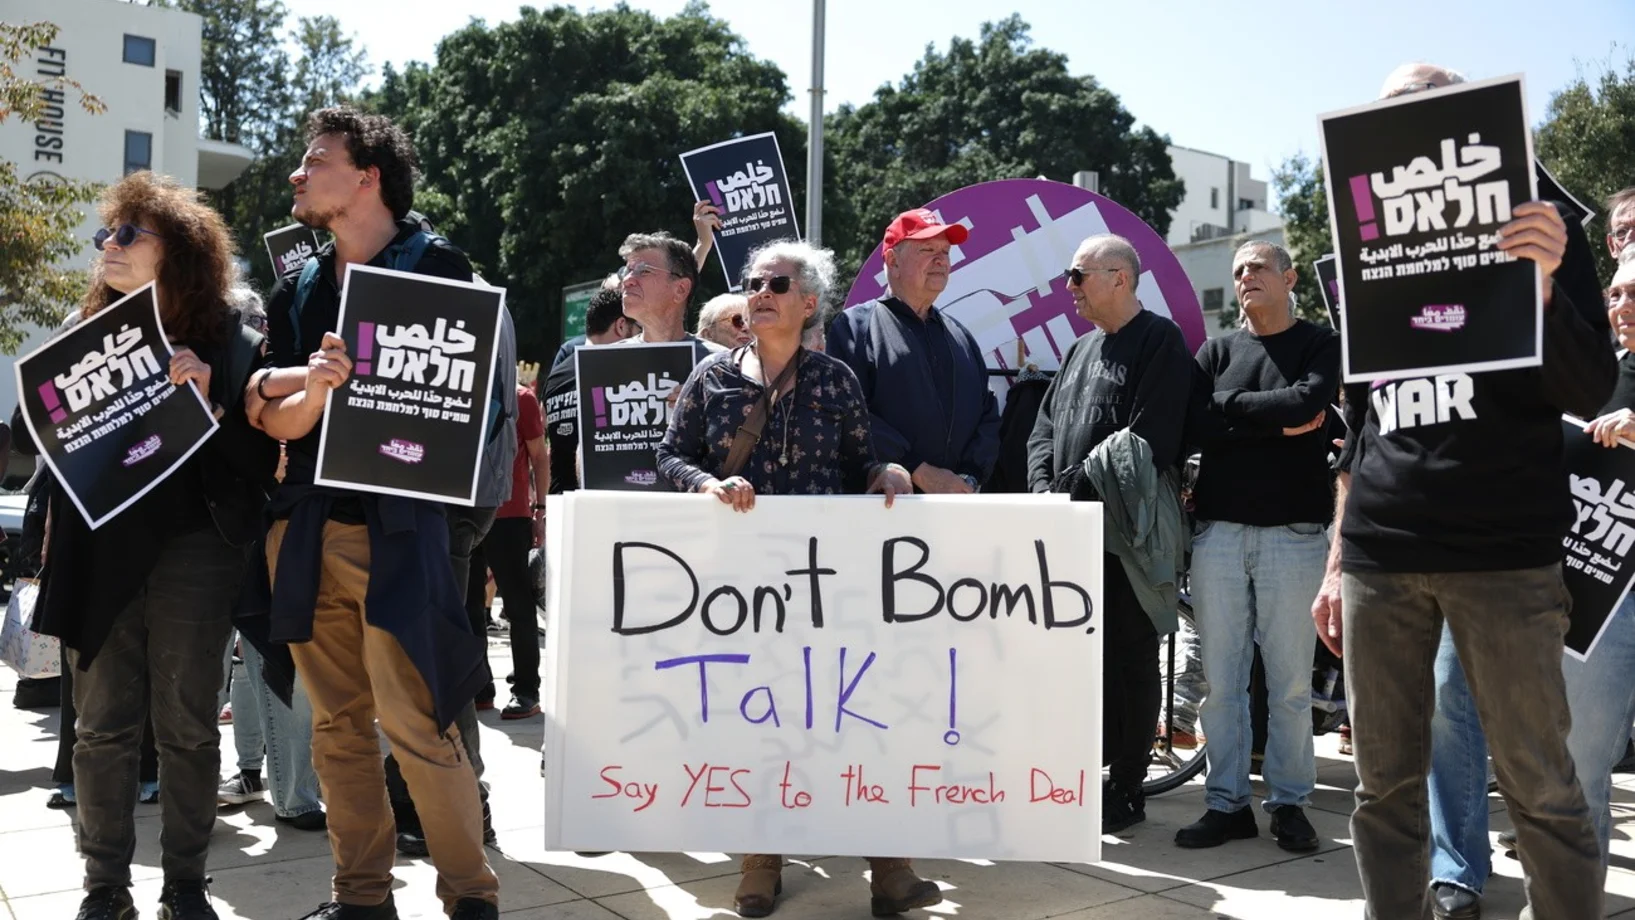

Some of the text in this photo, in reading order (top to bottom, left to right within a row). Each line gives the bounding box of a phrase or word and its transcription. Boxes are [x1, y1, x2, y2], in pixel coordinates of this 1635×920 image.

[716, 159, 774, 193] خلص
[1371, 132, 1502, 199] خلص
[1361, 265, 1393, 281] הנצח
[1396, 257, 1450, 276] למלחמת
[1453, 254, 1477, 271] סוף
[375, 317, 476, 354] خلص
[54, 324, 143, 389] خلص
[133, 404, 152, 416] סוף
[348, 396, 470, 423] שמים סוף למלחמת הנצח
[1371, 372, 1478, 436] WAR
[91, 412, 133, 439] למלחמת
[64, 434, 92, 454] הנצח
[1566, 554, 1614, 585] שמים סוף
[611, 536, 1096, 636] Don't Bomb.
[591, 761, 1085, 812] Say YES to the French Deal
